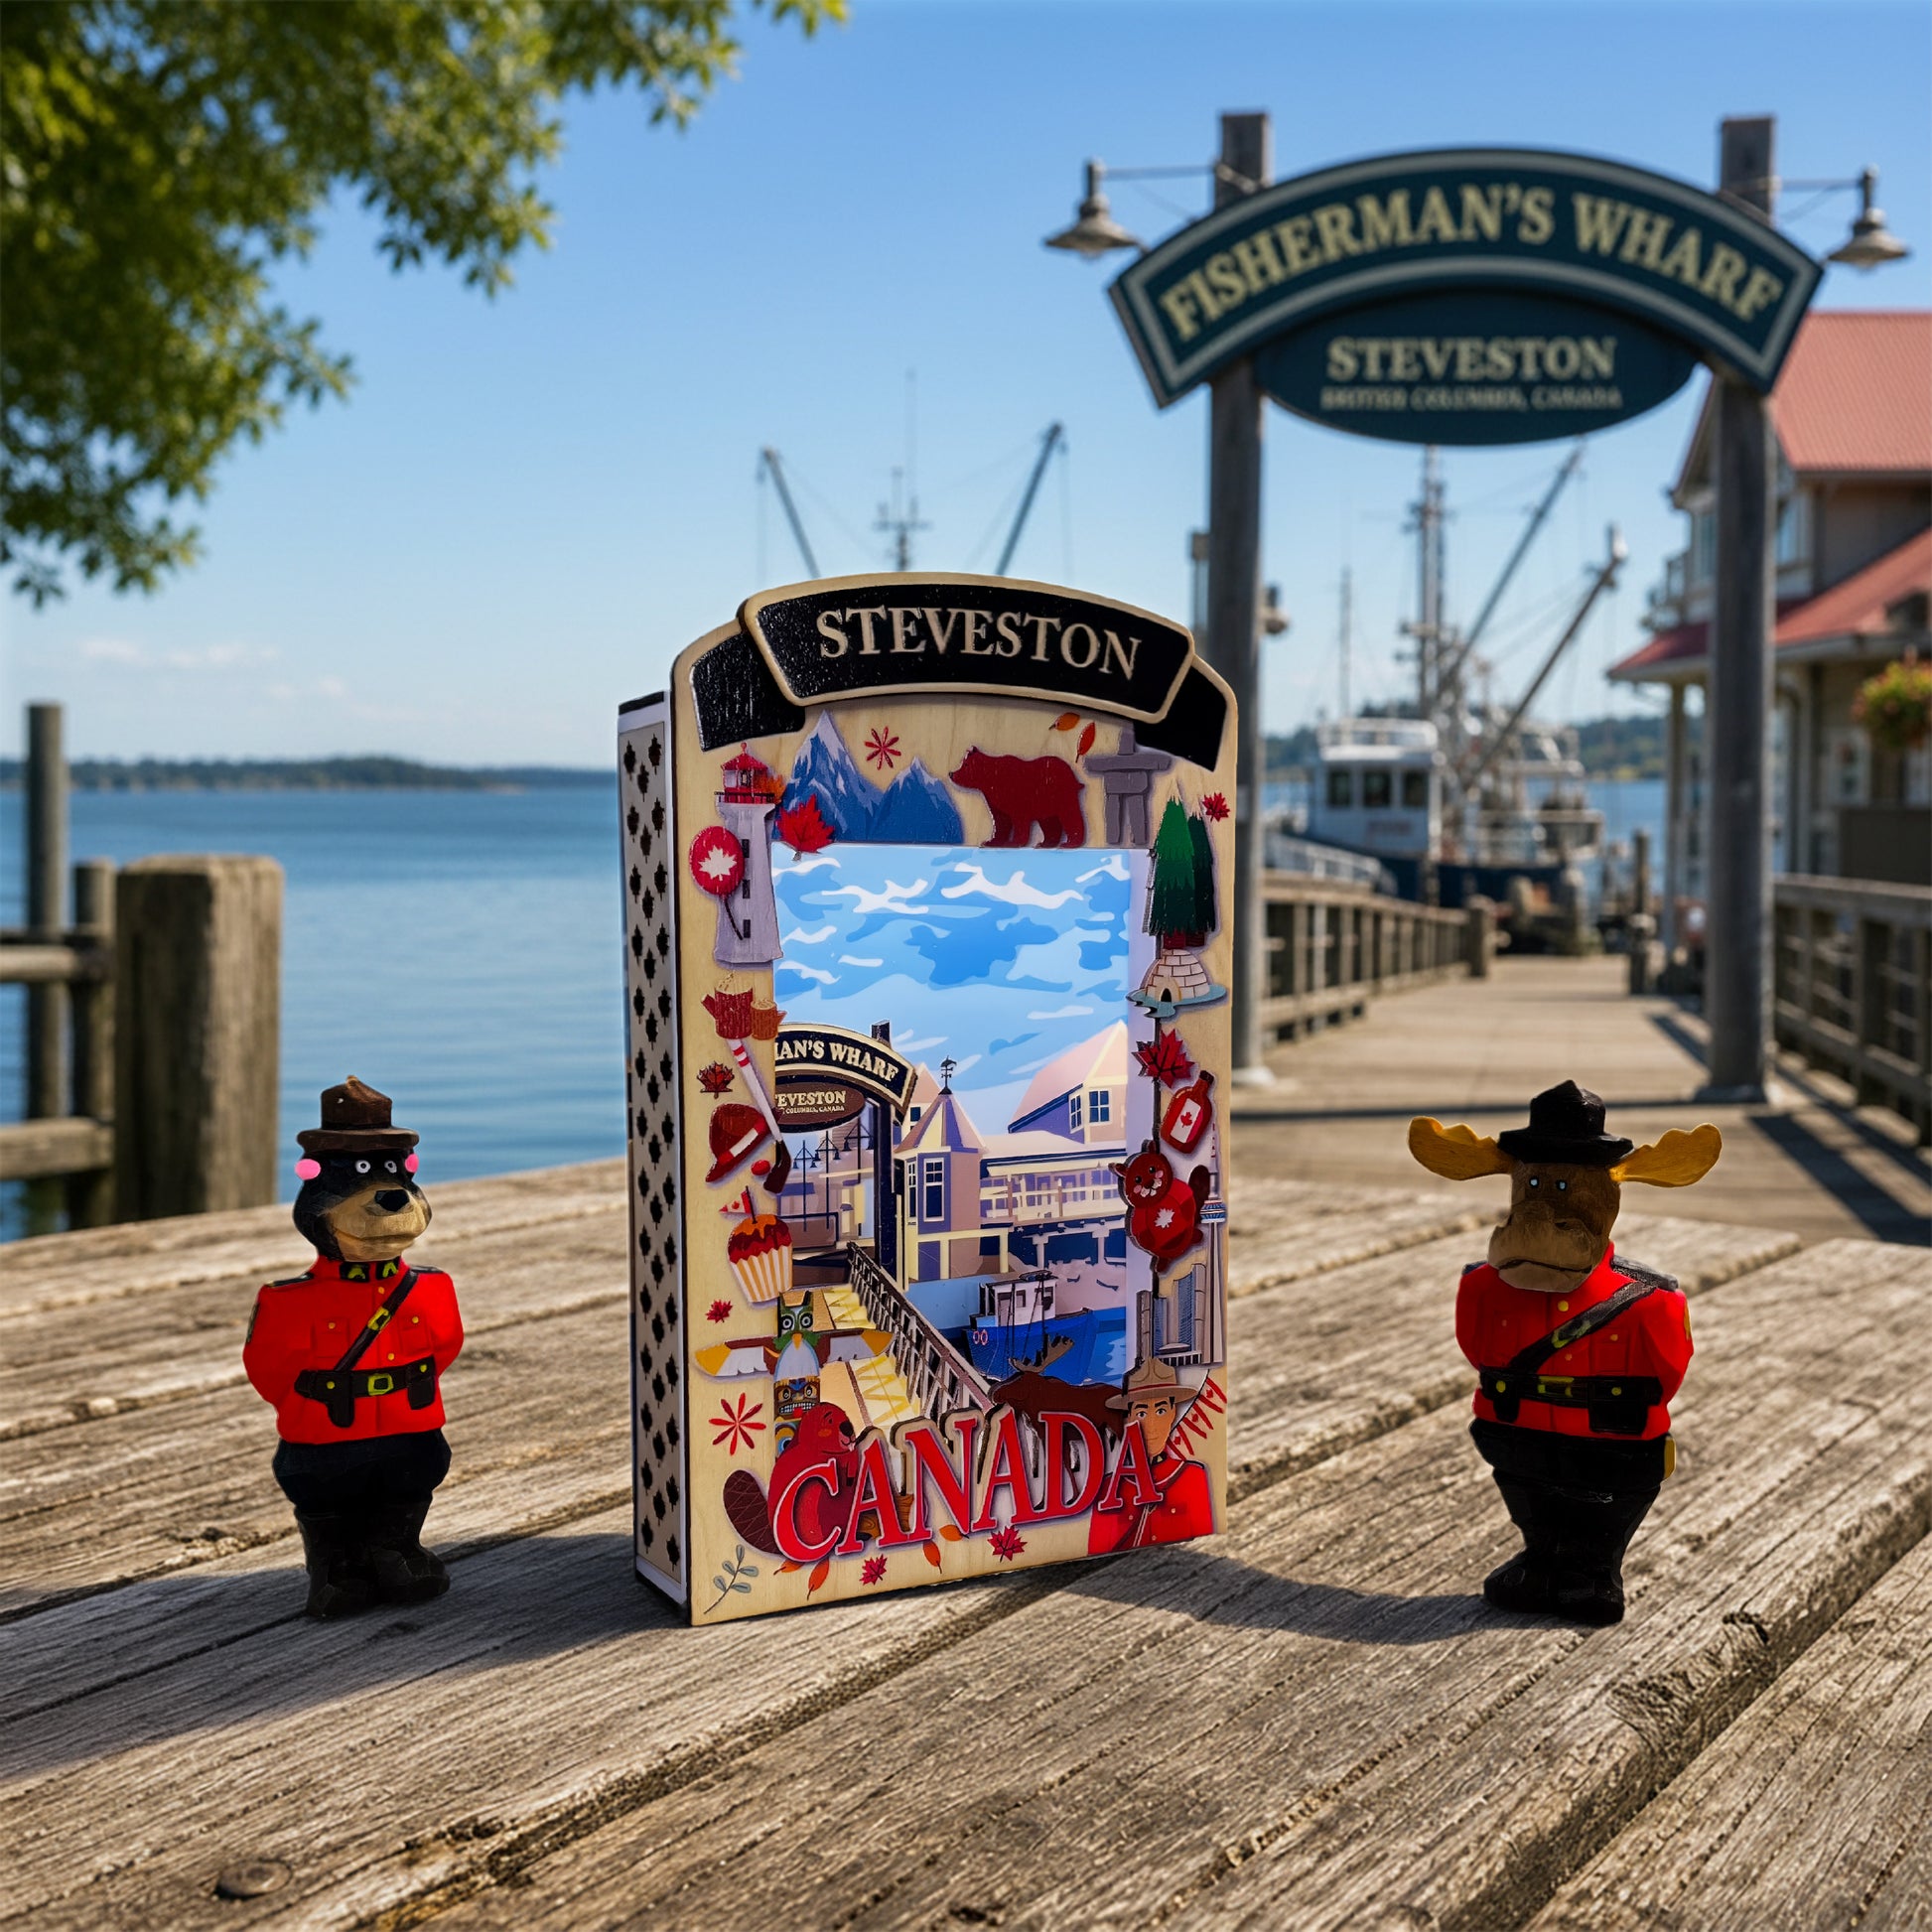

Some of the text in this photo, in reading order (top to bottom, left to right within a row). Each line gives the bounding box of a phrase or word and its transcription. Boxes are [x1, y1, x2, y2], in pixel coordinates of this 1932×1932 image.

[1158, 183, 1783, 342] FISHERMAN'S WHARF
[1326, 336, 1617, 381] STEVESTON
[816, 606, 1142, 681] STEVESTON
[829, 1042, 898, 1081] WHARF
[775, 1090, 846, 1107] EVESTON
[771, 1406, 1164, 1563] CANADA
